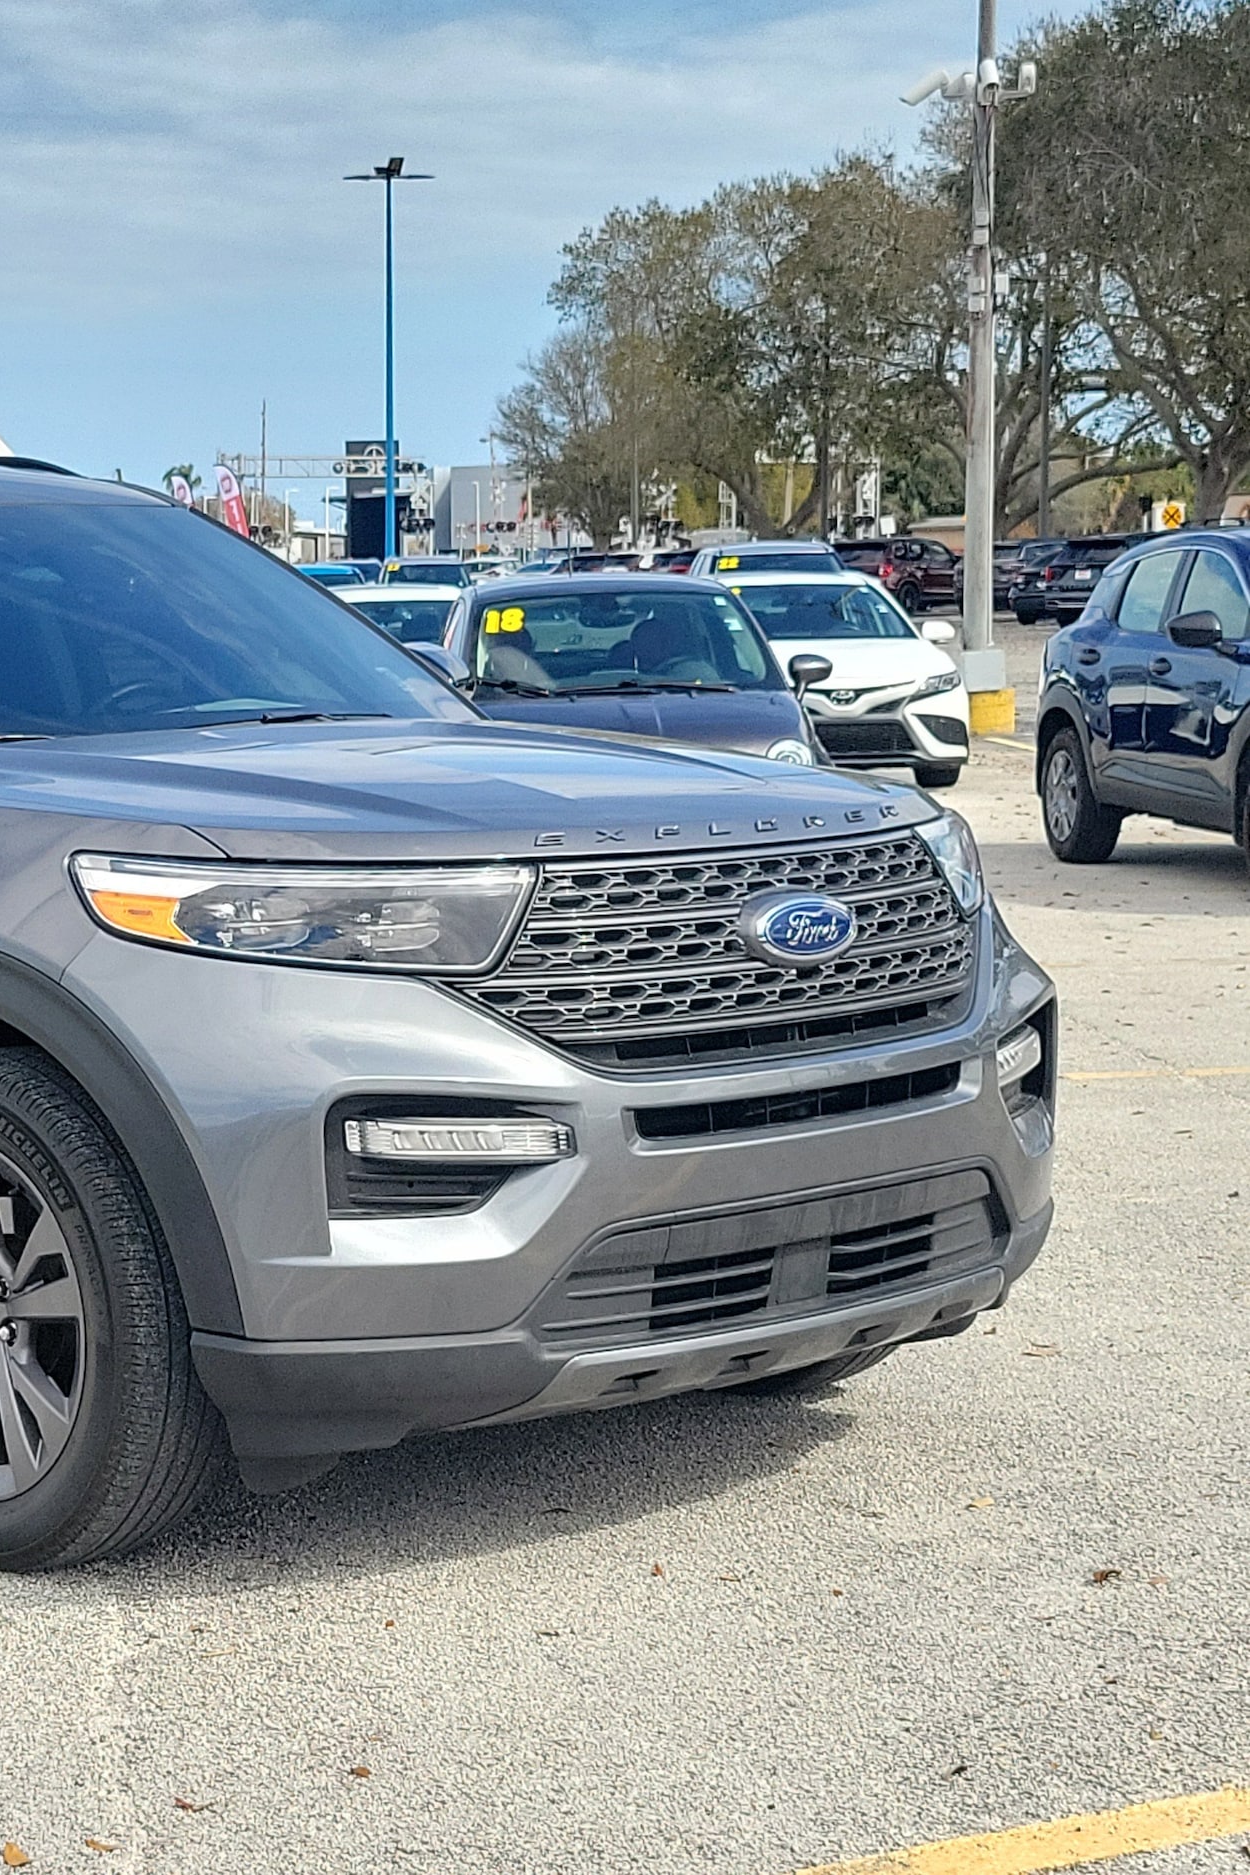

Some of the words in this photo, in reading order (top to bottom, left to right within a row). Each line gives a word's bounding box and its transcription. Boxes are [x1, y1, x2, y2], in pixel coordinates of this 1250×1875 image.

[485, 606, 525, 634] 18
[533, 803, 900, 848] EXPLORER
[786, 908, 839, 946] Ford
